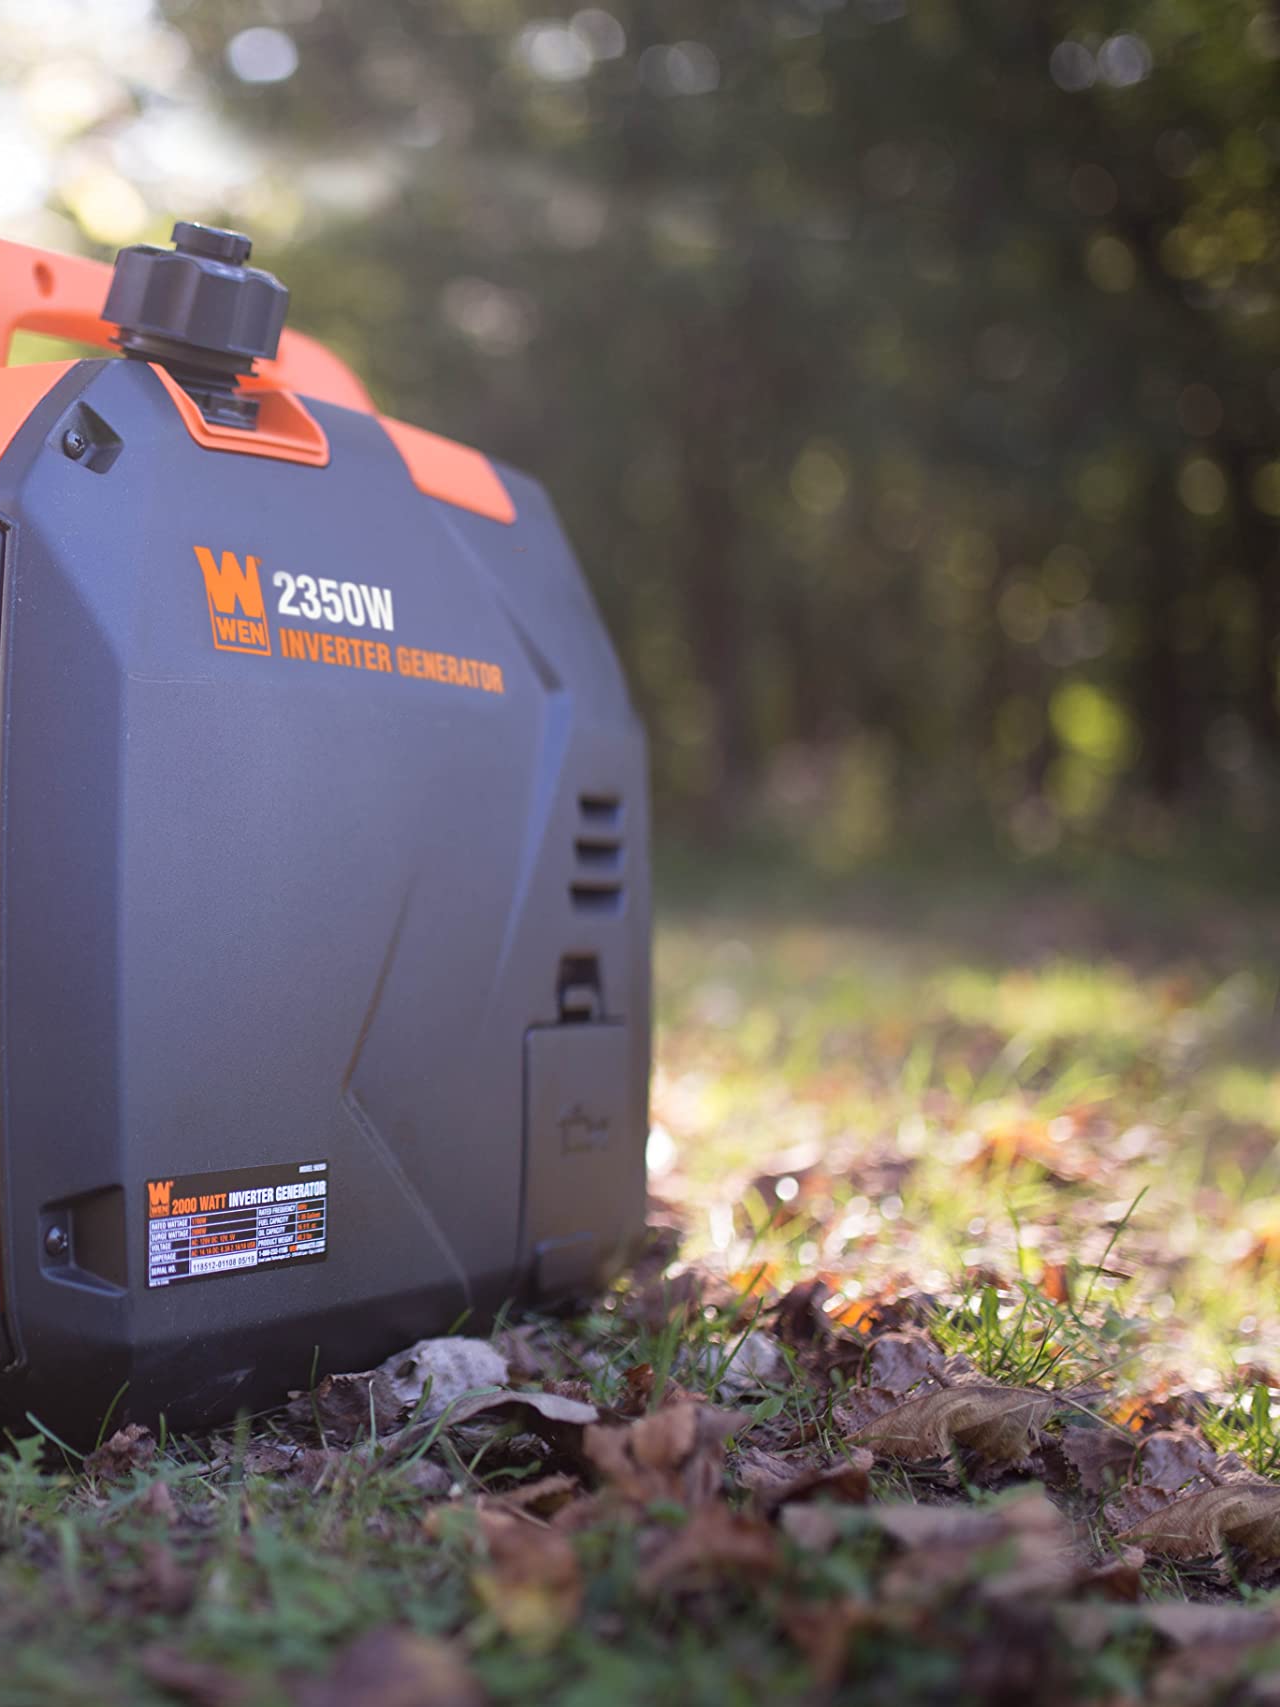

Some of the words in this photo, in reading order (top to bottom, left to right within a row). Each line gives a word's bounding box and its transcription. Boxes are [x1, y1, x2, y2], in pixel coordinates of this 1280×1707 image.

[273, 571, 394, 632] 2350W
[216, 616, 266, 646] WEN
[279, 628, 393, 673] INVERTER
[396, 645, 504, 694] GENERATOR
[172, 1197, 197, 1215] 2000
[199, 1193, 226, 1211] WATT
[228, 1188, 274, 1208] INVERTER
[275, 1181, 326, 1201] GENERATOR
[258, 1208, 271, 1216] RATED
[151, 1222, 166, 1230] RATED
[167, 1219, 188, 1229] WATTAGE
[259, 1218, 268, 1226] FUEL
[269, 1216, 289, 1225] CAPACITY
[168, 1229, 189, 1239] WATTAGE
[266, 1226, 285, 1236] CAPACITY
[151, 1242, 172, 1252] VOLTAGE
[258, 1238, 277, 1247] PRODUCT
[151, 1266, 167, 1276] SERIAL
